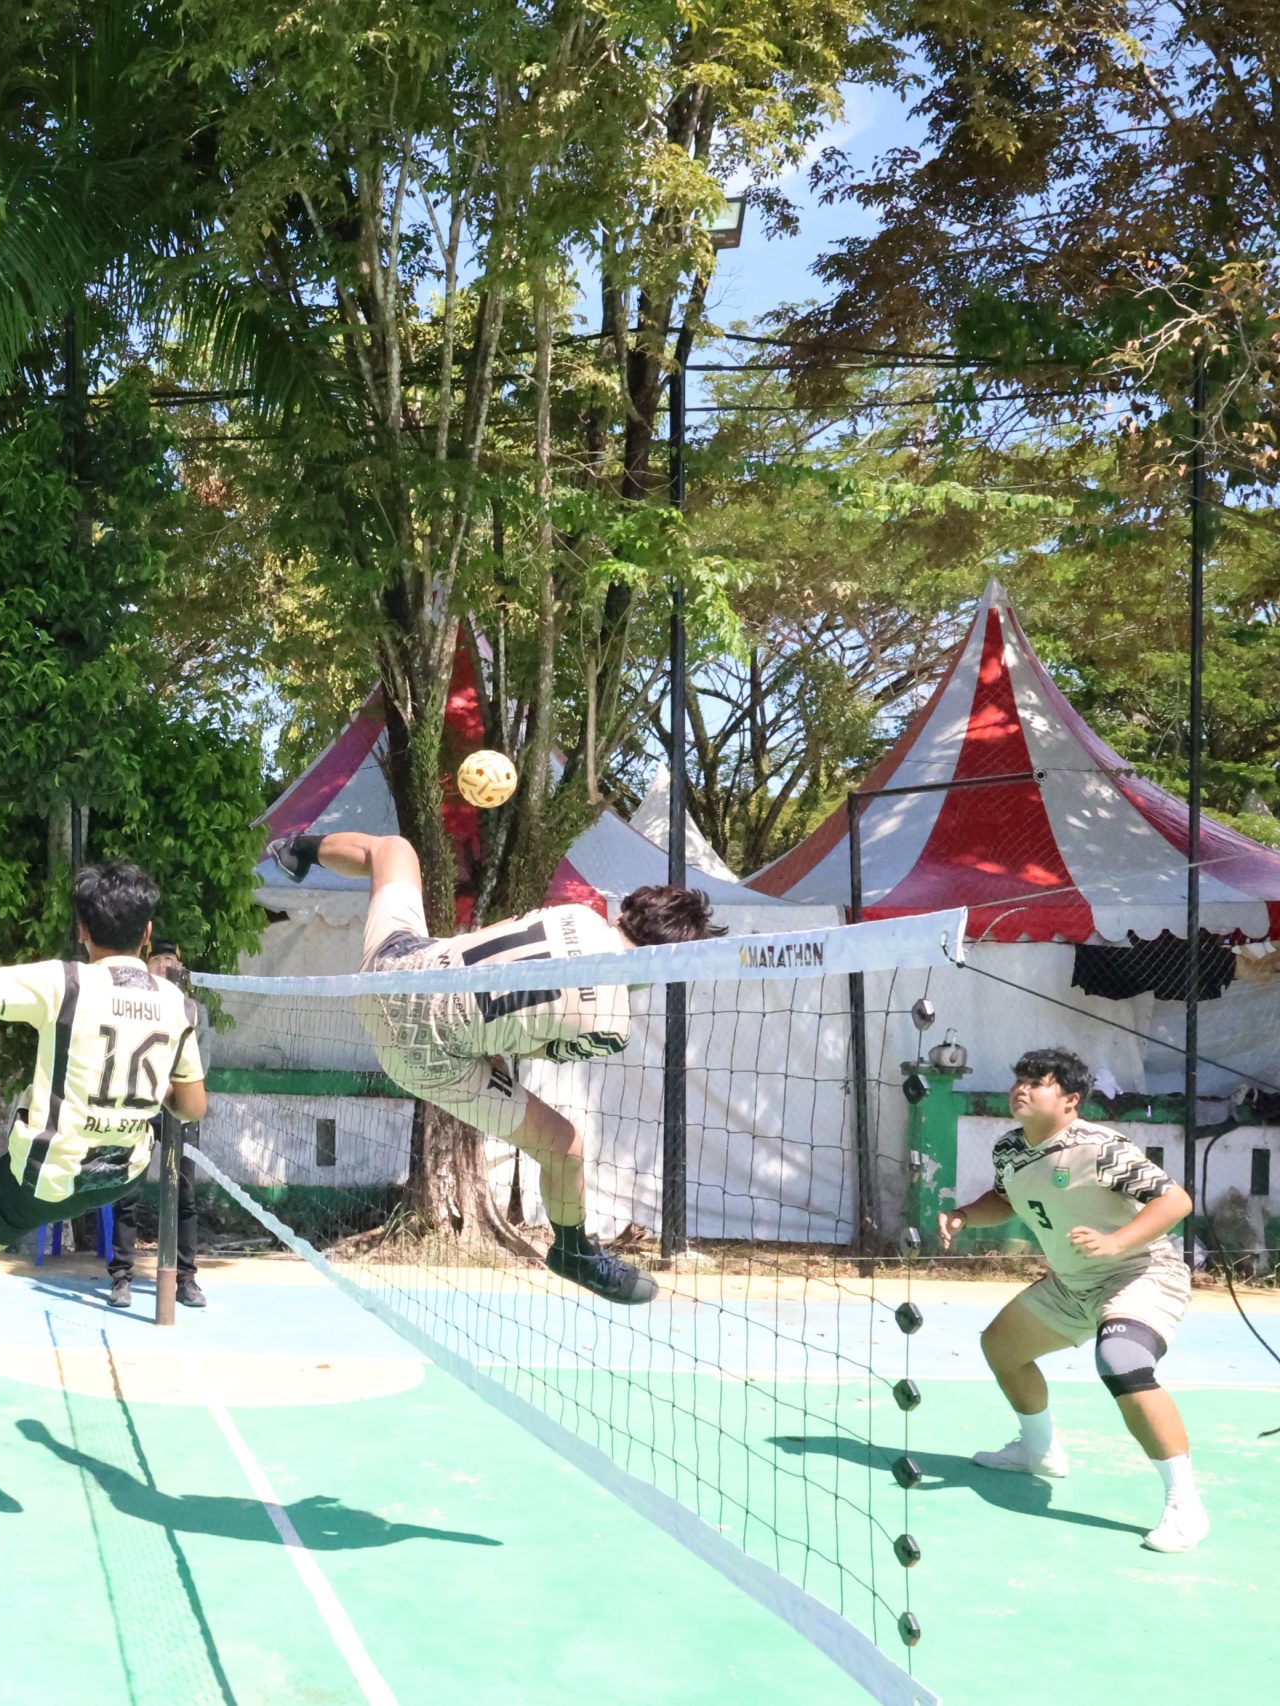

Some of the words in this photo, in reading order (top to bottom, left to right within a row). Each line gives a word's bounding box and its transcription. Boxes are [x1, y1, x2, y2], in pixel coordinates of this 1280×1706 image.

[748, 942, 824, 968] MARATHON
[111, 998, 161, 1022] WAHYU
[87, 1024, 170, 1109] 16
[83, 1116, 112, 1134] ALL
[1027, 1200, 1054, 1230] 3
